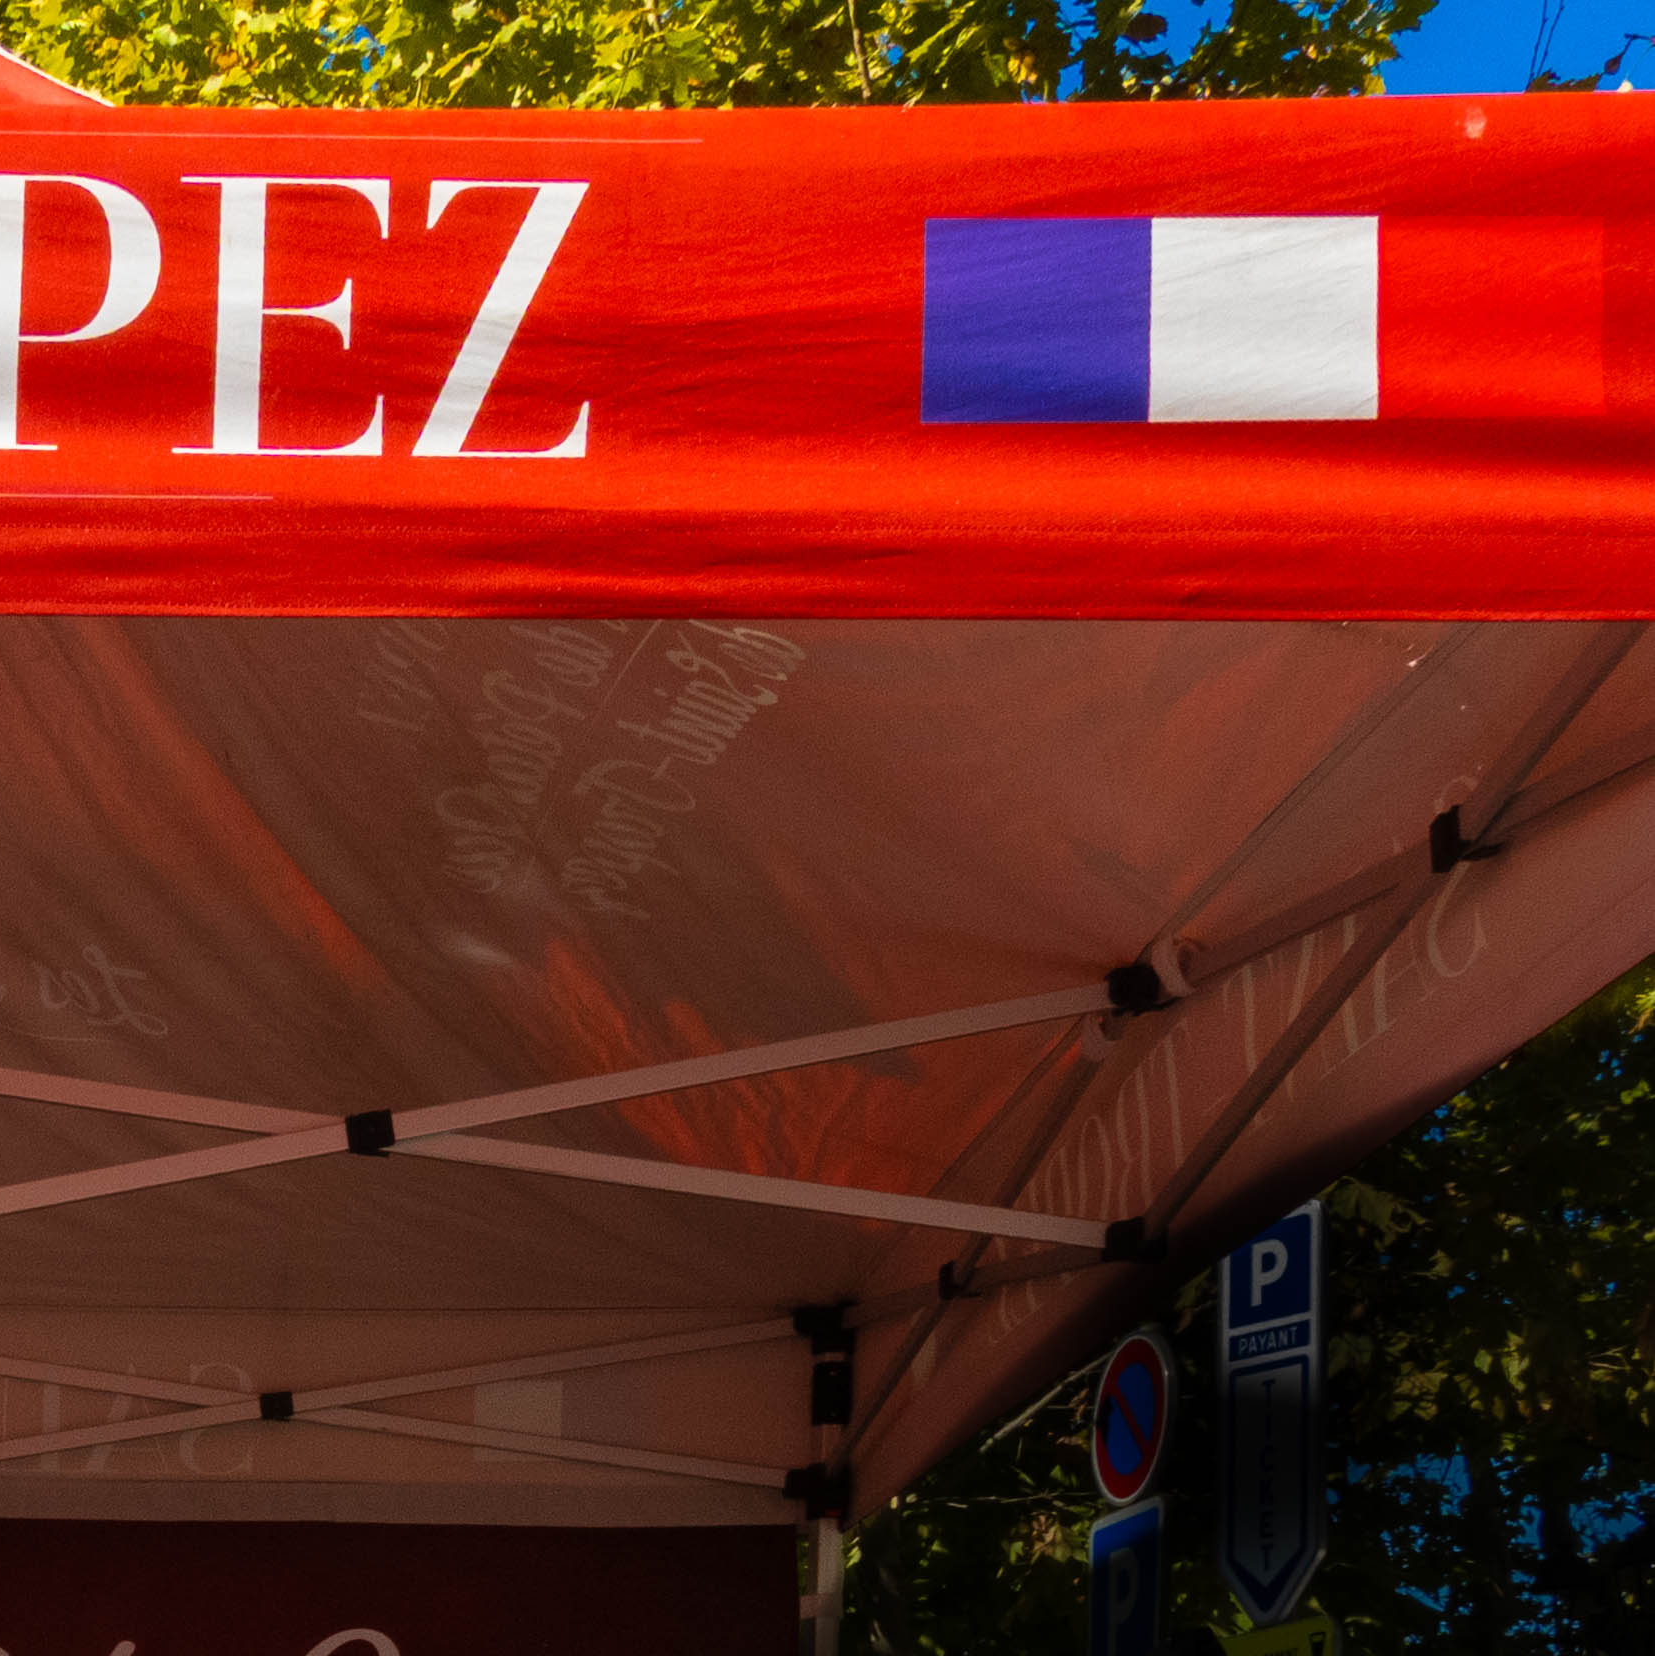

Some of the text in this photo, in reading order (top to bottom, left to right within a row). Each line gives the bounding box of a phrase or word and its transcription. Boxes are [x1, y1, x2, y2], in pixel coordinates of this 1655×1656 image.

[1250, 1238, 1289, 1309] P
[1238, 1325, 1300, 1357] PAYANT
[1258, 1378, 1276, 1572] TICKET
